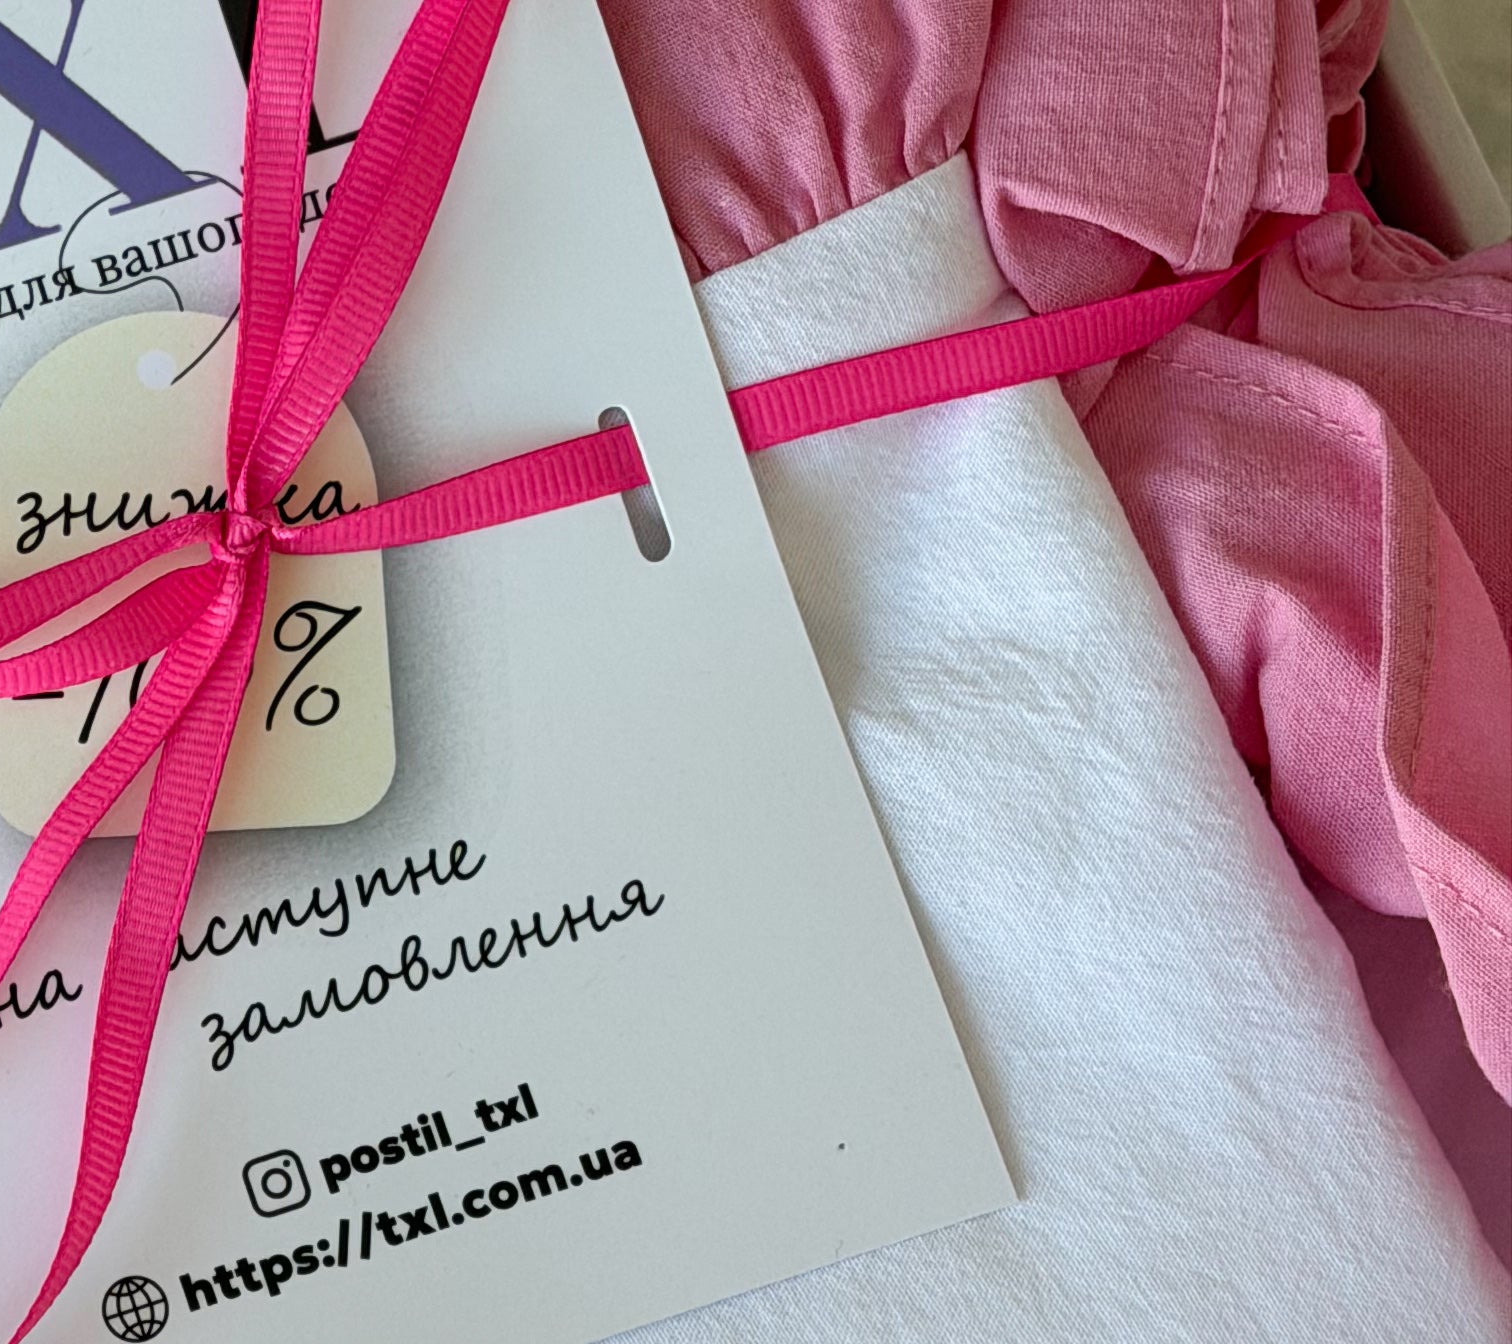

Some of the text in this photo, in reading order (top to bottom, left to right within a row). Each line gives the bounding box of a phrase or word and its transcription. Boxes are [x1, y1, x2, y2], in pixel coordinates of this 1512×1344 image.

[95, 213, 245, 288] вашог
[169, 838, 487, 972] ступне
[200, 878, 666, 1072] замовлення
[318, 1082, 540, 1195] postil_txl
[178, 1139, 644, 1313] https://txl.com.ua
